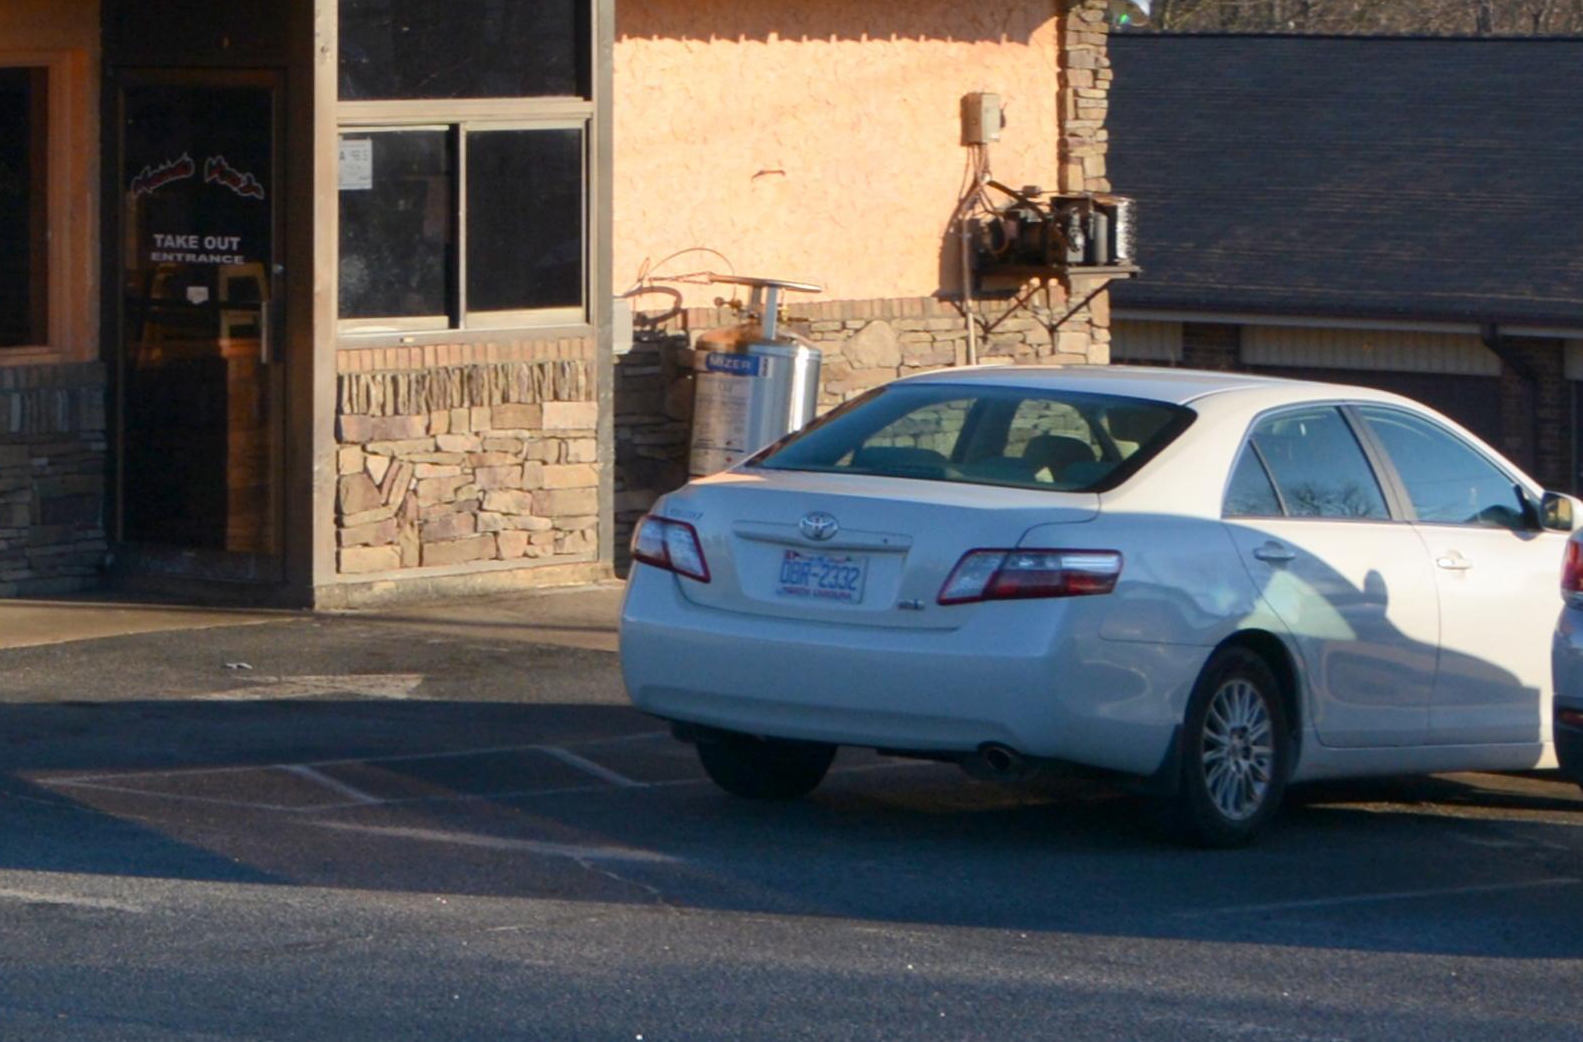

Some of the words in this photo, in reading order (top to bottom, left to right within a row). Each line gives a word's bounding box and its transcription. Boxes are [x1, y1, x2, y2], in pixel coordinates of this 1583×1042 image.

[153, 234, 199, 249] TAKE
[203, 236, 241, 250] OUT
[150, 252, 245, 264] ENTRANCE
